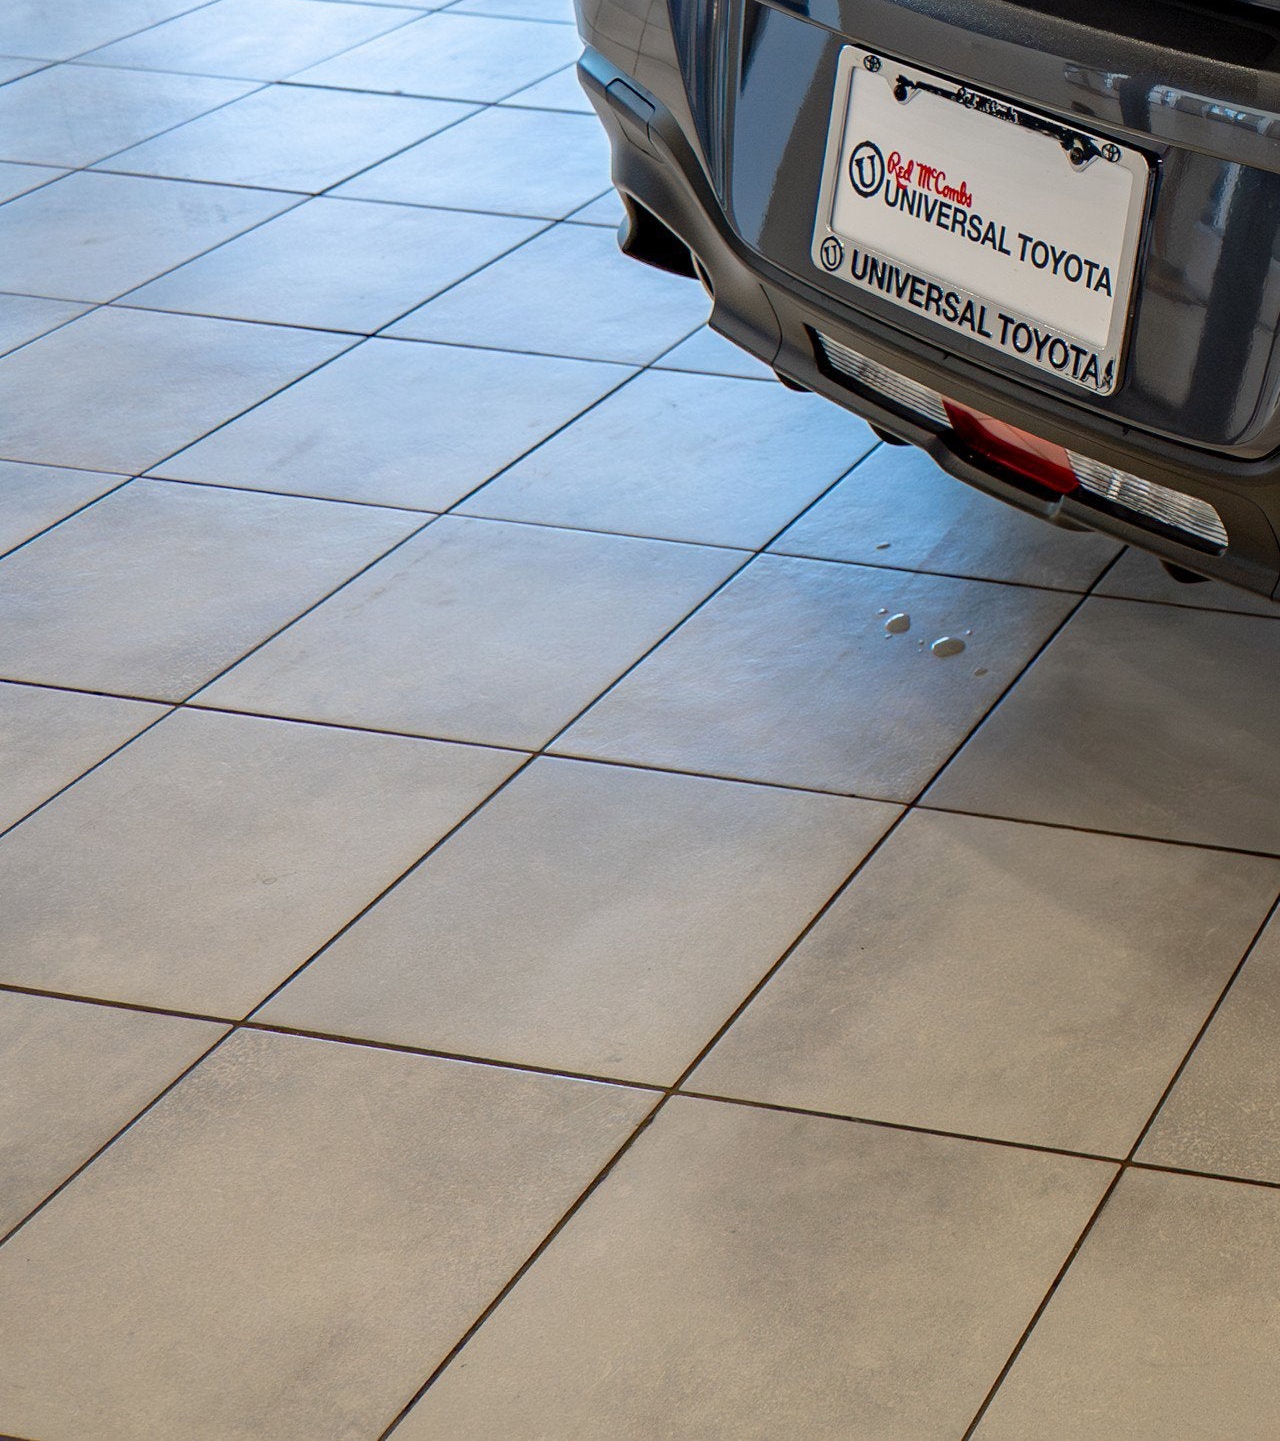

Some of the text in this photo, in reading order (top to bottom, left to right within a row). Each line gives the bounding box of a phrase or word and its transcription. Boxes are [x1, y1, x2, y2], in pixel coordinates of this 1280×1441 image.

[884, 178, 1011, 256] UNIVERSAL
[1017, 232, 1113, 297] TOYOTA
[887, 151, 973, 208] Red McCombs
[851, 249, 993, 339] UNIVERSAL
[998, 312, 1102, 389] TOYOTA
